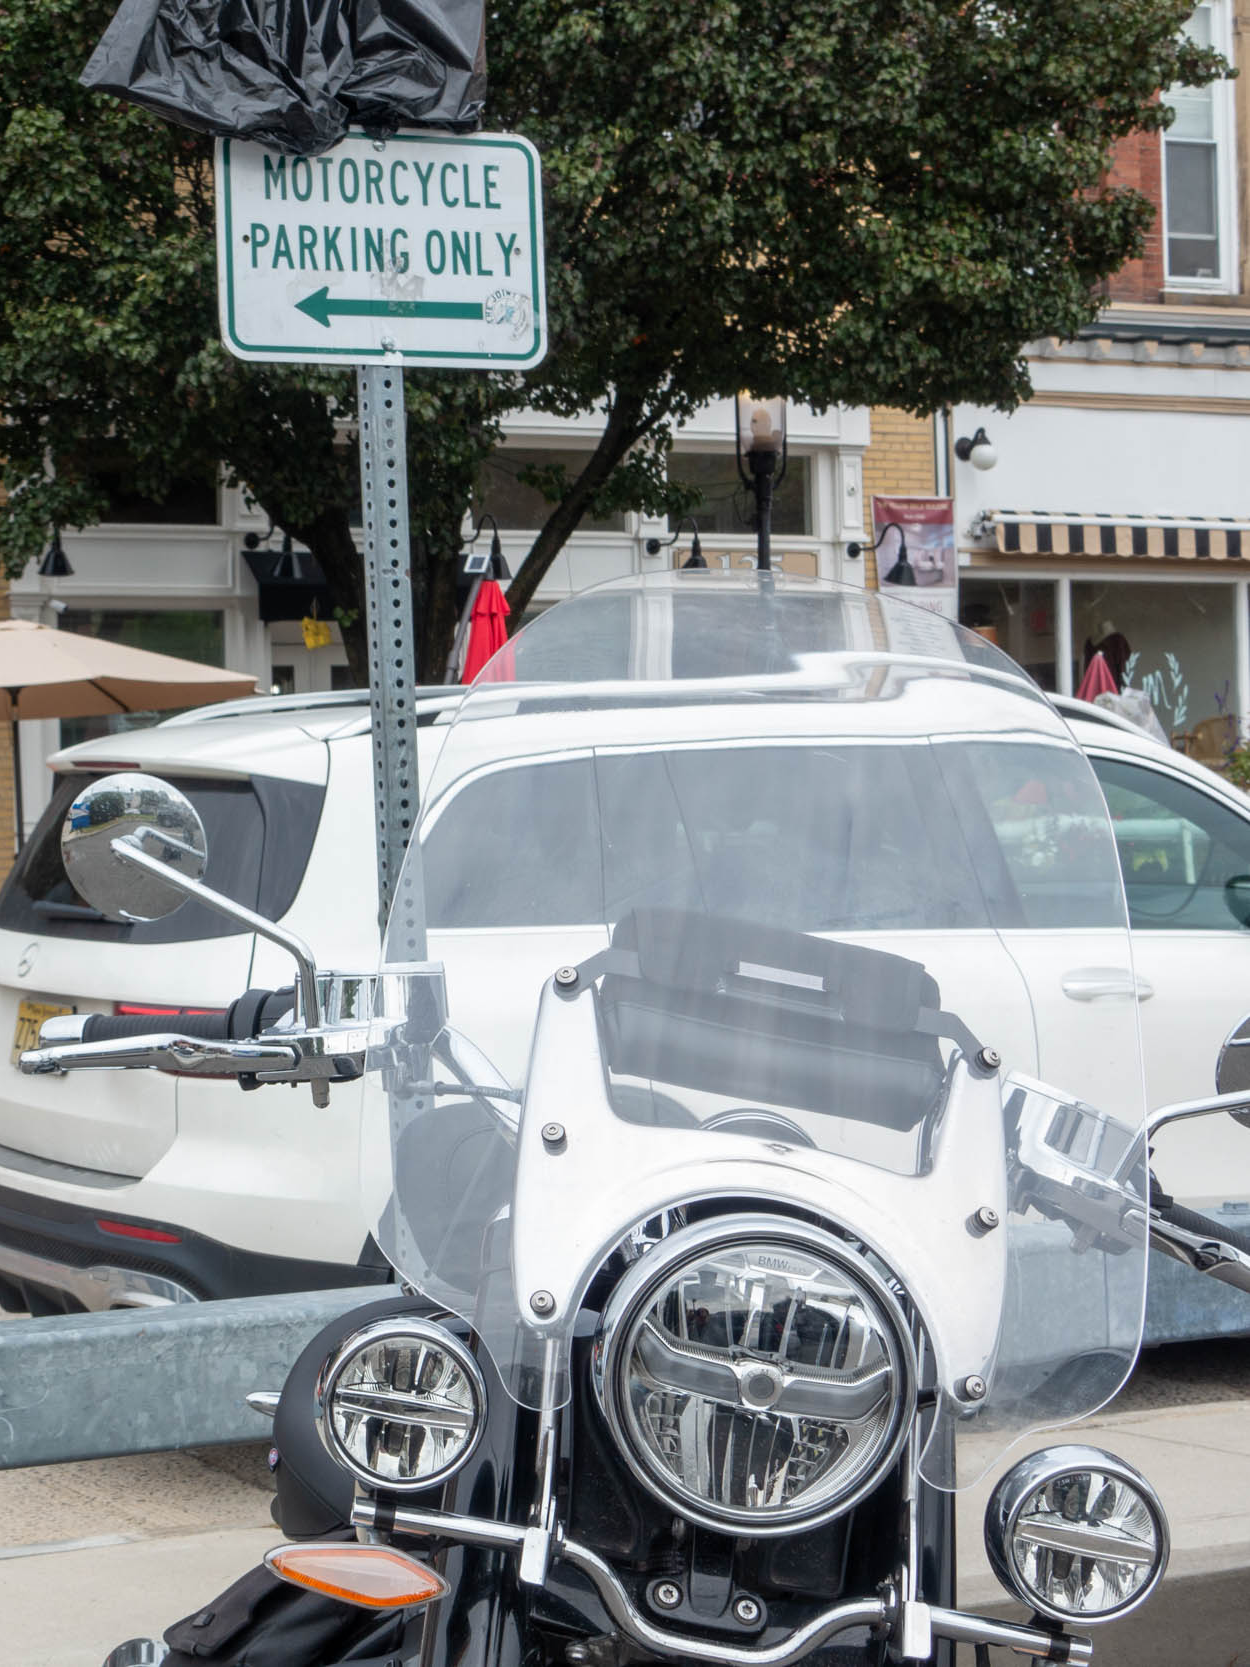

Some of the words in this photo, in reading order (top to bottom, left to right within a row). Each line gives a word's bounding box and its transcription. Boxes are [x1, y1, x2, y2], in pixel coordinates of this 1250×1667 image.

[263, 153, 502, 210] MOTORCYCLE
[250, 222, 410, 275] PARKING
[425, 229, 518, 277] ONLY
[757, 1255, 789, 1270] BMW
